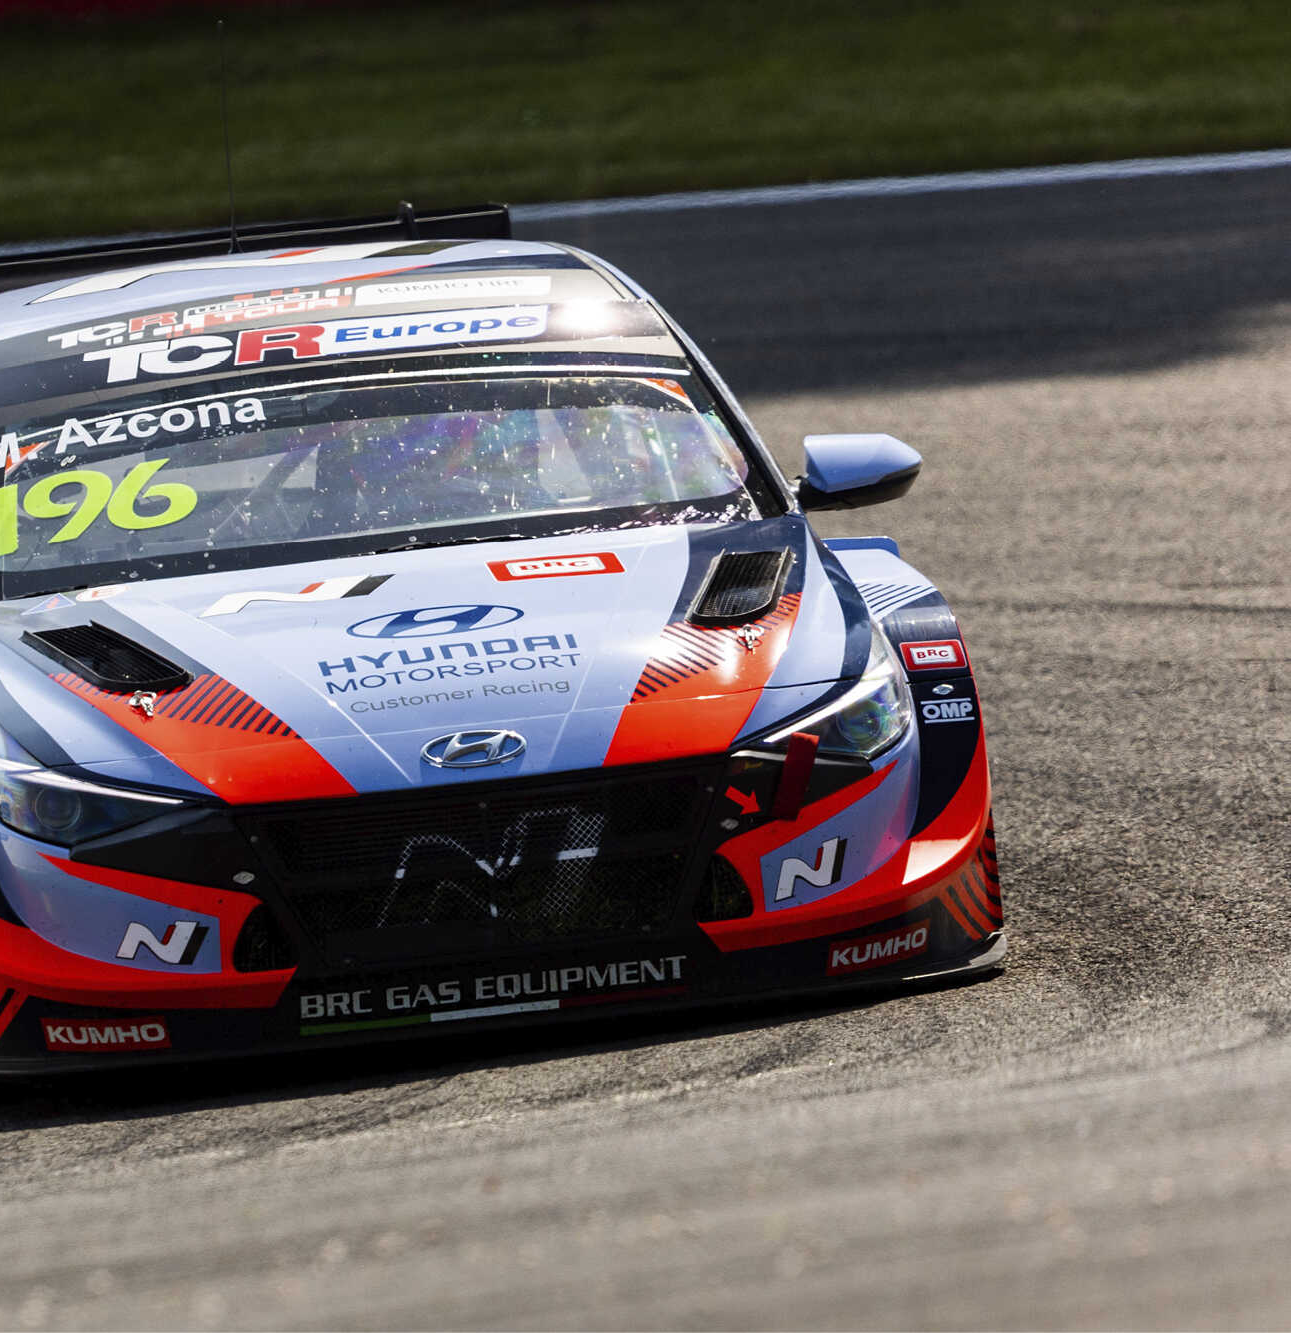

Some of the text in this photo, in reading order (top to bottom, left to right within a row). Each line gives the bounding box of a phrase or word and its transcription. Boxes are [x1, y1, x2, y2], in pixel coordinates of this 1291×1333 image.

[82, 314, 540, 384] TCR Europe
[54, 396, 267, 455] Azcona
[318, 633, 578, 677] HYUNDAI
[916, 646, 950, 660] BRC
[326, 653, 581, 695] MOTORSPORT
[350, 679, 571, 714] Customer Racing
[922, 701, 973, 721] OMP
[831, 927, 928, 967] KUMHO
[300, 955, 687, 1019] BRC GAS EQUIPMENT
[46, 1023, 166, 1045] KUMHO
